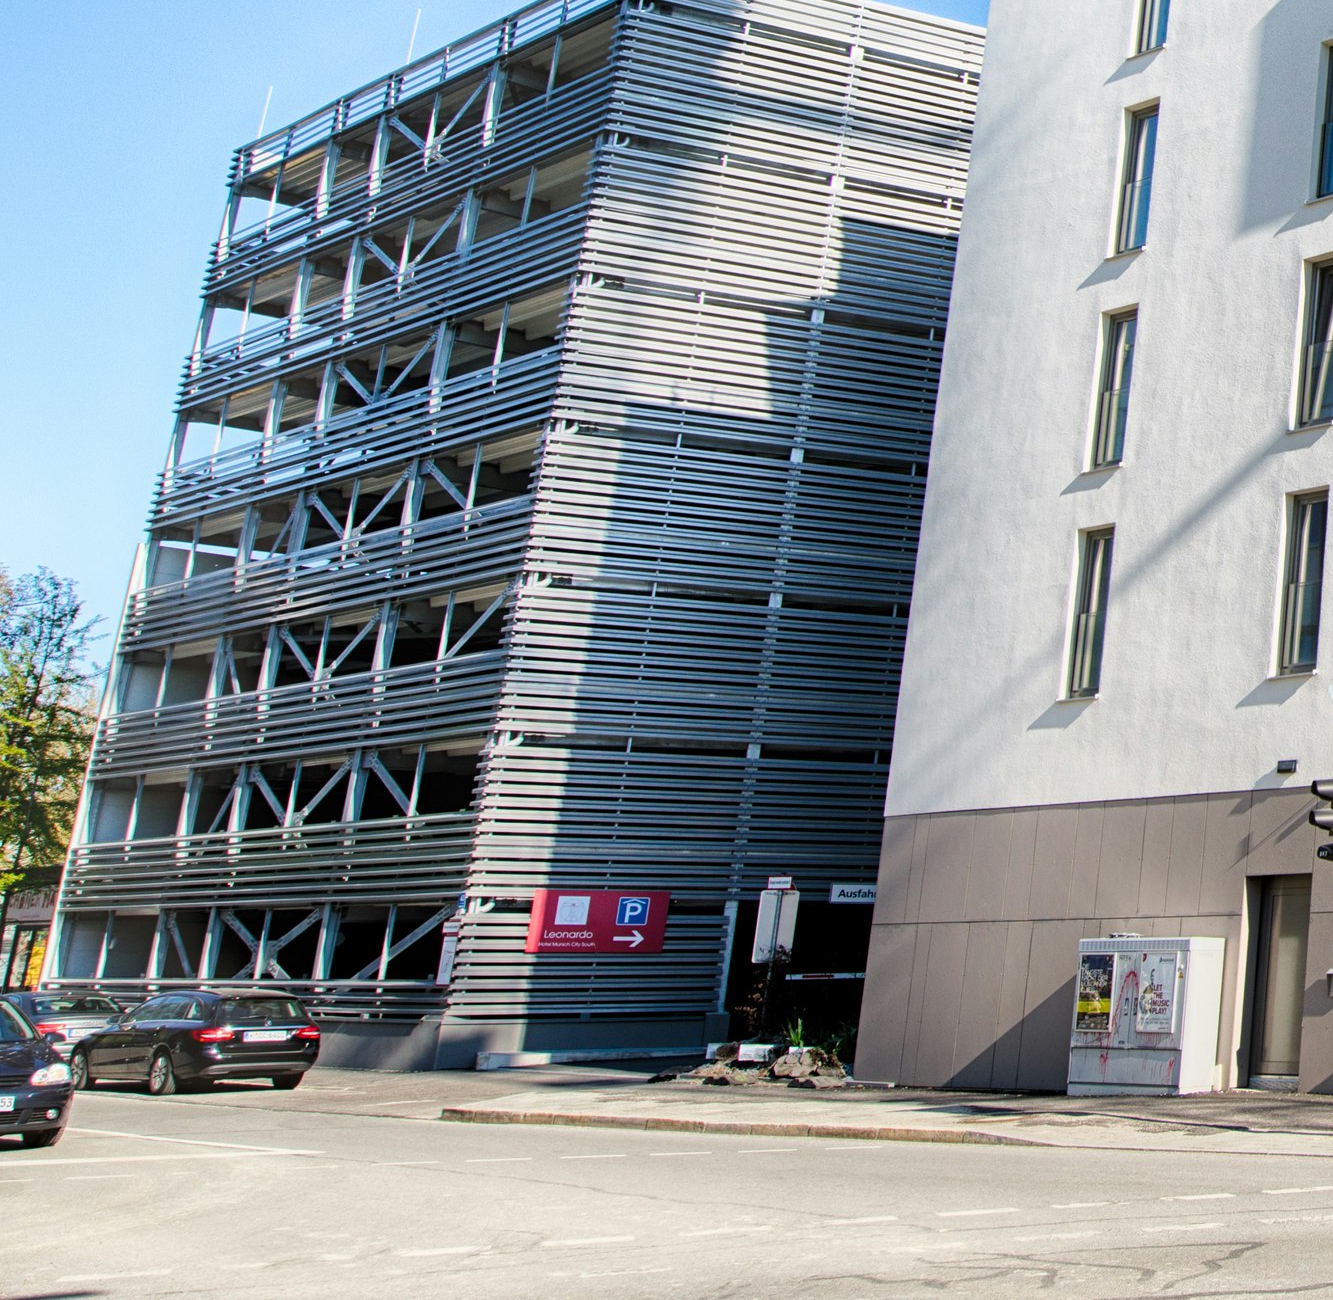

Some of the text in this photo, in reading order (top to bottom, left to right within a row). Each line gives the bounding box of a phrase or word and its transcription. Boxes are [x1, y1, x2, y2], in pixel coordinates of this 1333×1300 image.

[543, 930, 594, 939] Leonardo
[1153, 984, 1163, 992] LET
[1152, 999, 1170, 1007] MUSIC
